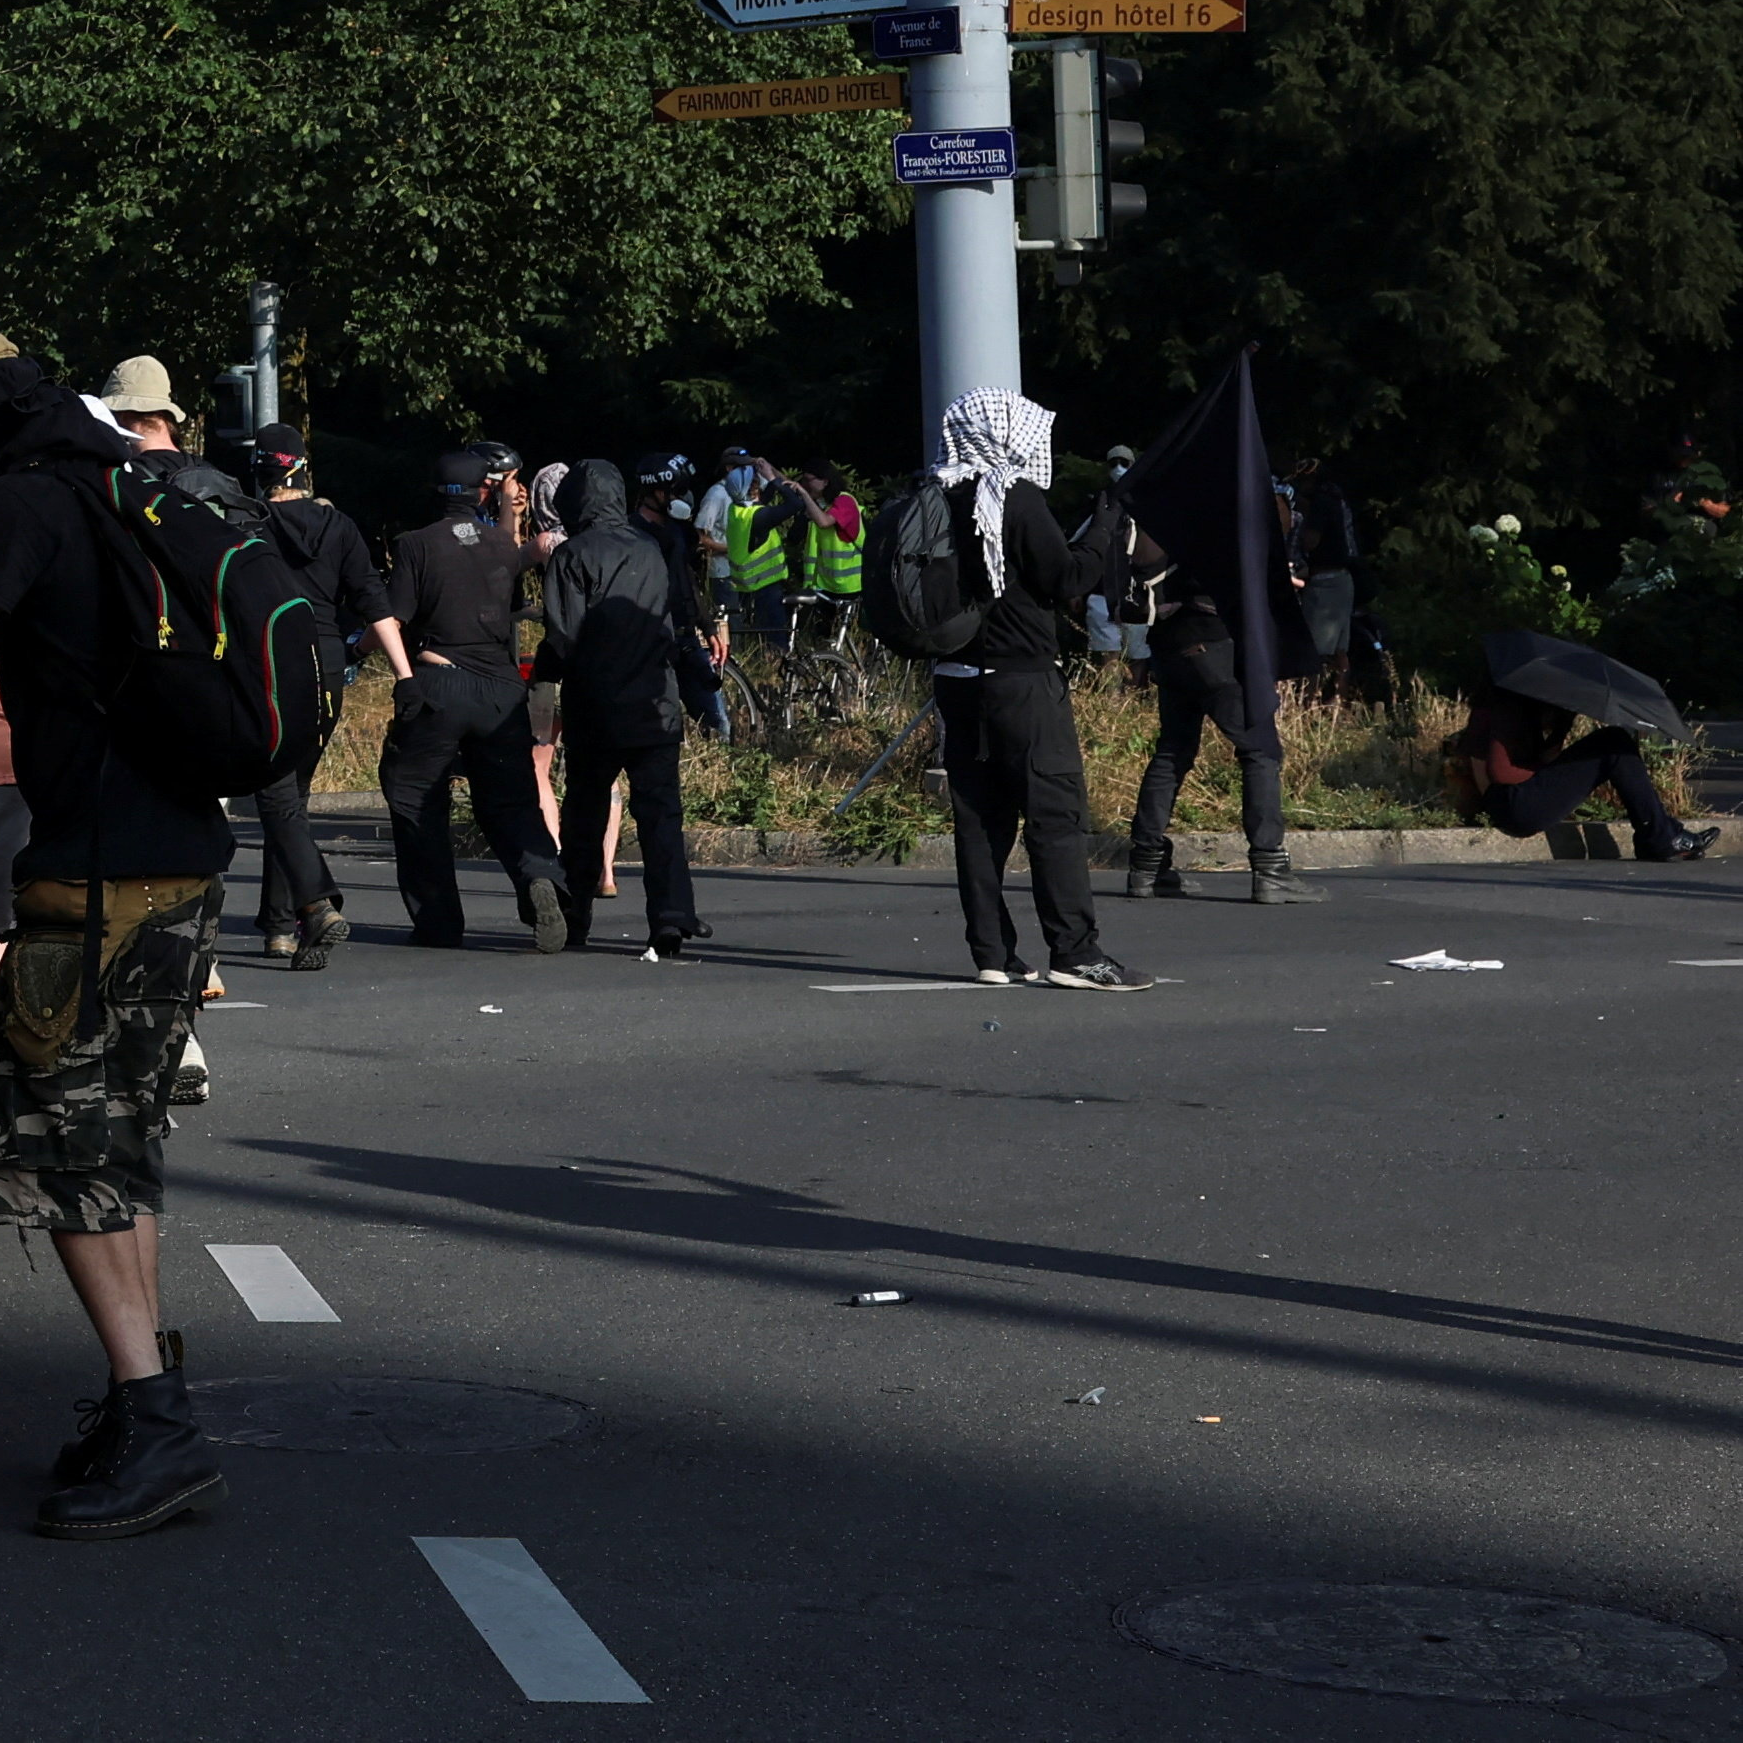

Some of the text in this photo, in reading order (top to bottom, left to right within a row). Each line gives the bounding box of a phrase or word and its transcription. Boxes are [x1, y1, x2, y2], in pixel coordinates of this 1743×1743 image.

[889, 16, 941, 33] Avenue de
[1027, 4, 1211, 31] design hôtel f6
[900, 35, 932, 48] France
[678, 82, 891, 113] FAIRMONT GRAND HOTEL
[930, 134, 976, 150] Carrefour
[902, 149, 1007, 169] François-FORESTIER
